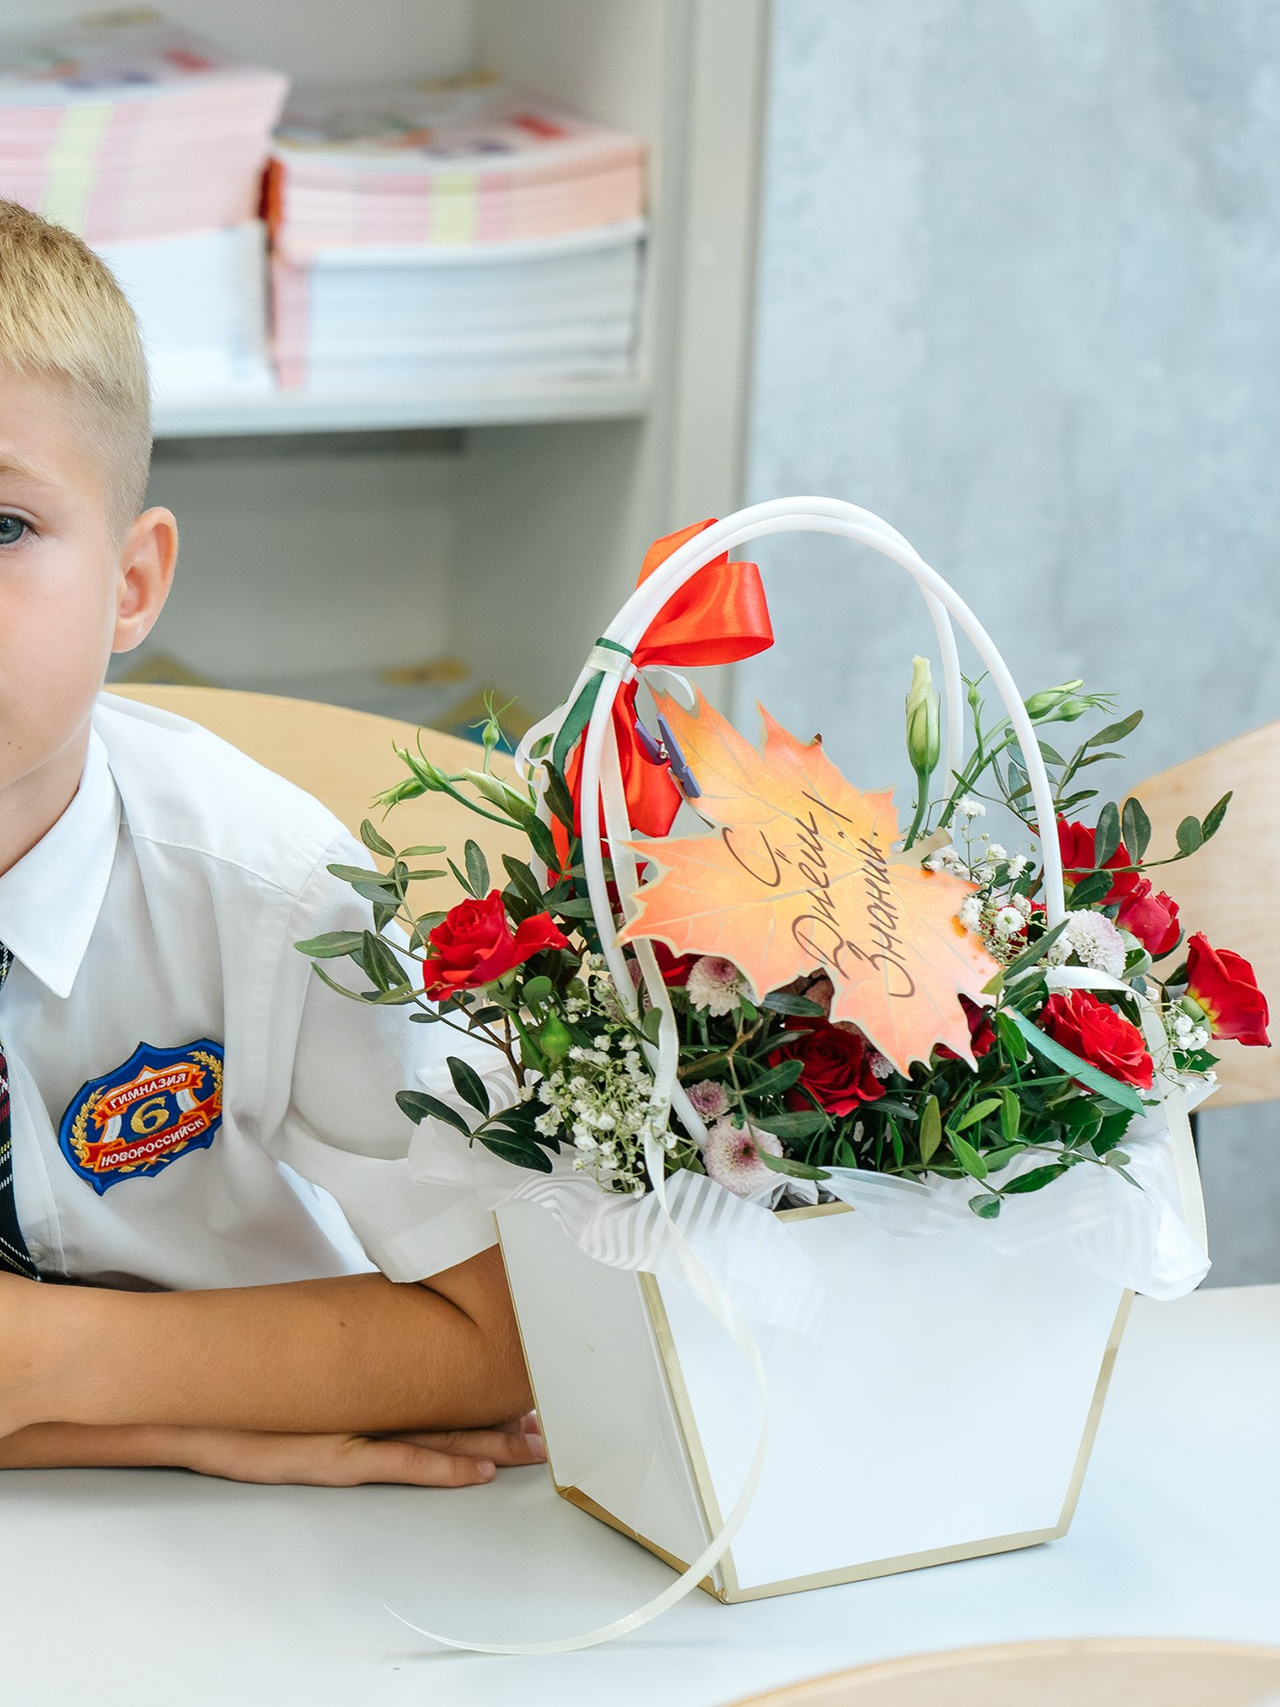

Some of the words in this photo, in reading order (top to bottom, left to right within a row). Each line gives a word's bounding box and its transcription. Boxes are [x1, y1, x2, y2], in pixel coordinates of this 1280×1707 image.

[722, 826, 781, 888] С
[109, 1073, 187, 1109] ГИМНАЗИЯ
[130, 1096, 170, 1134] 6
[100, 1117, 205, 1167] НОВОРОССИЙСК
